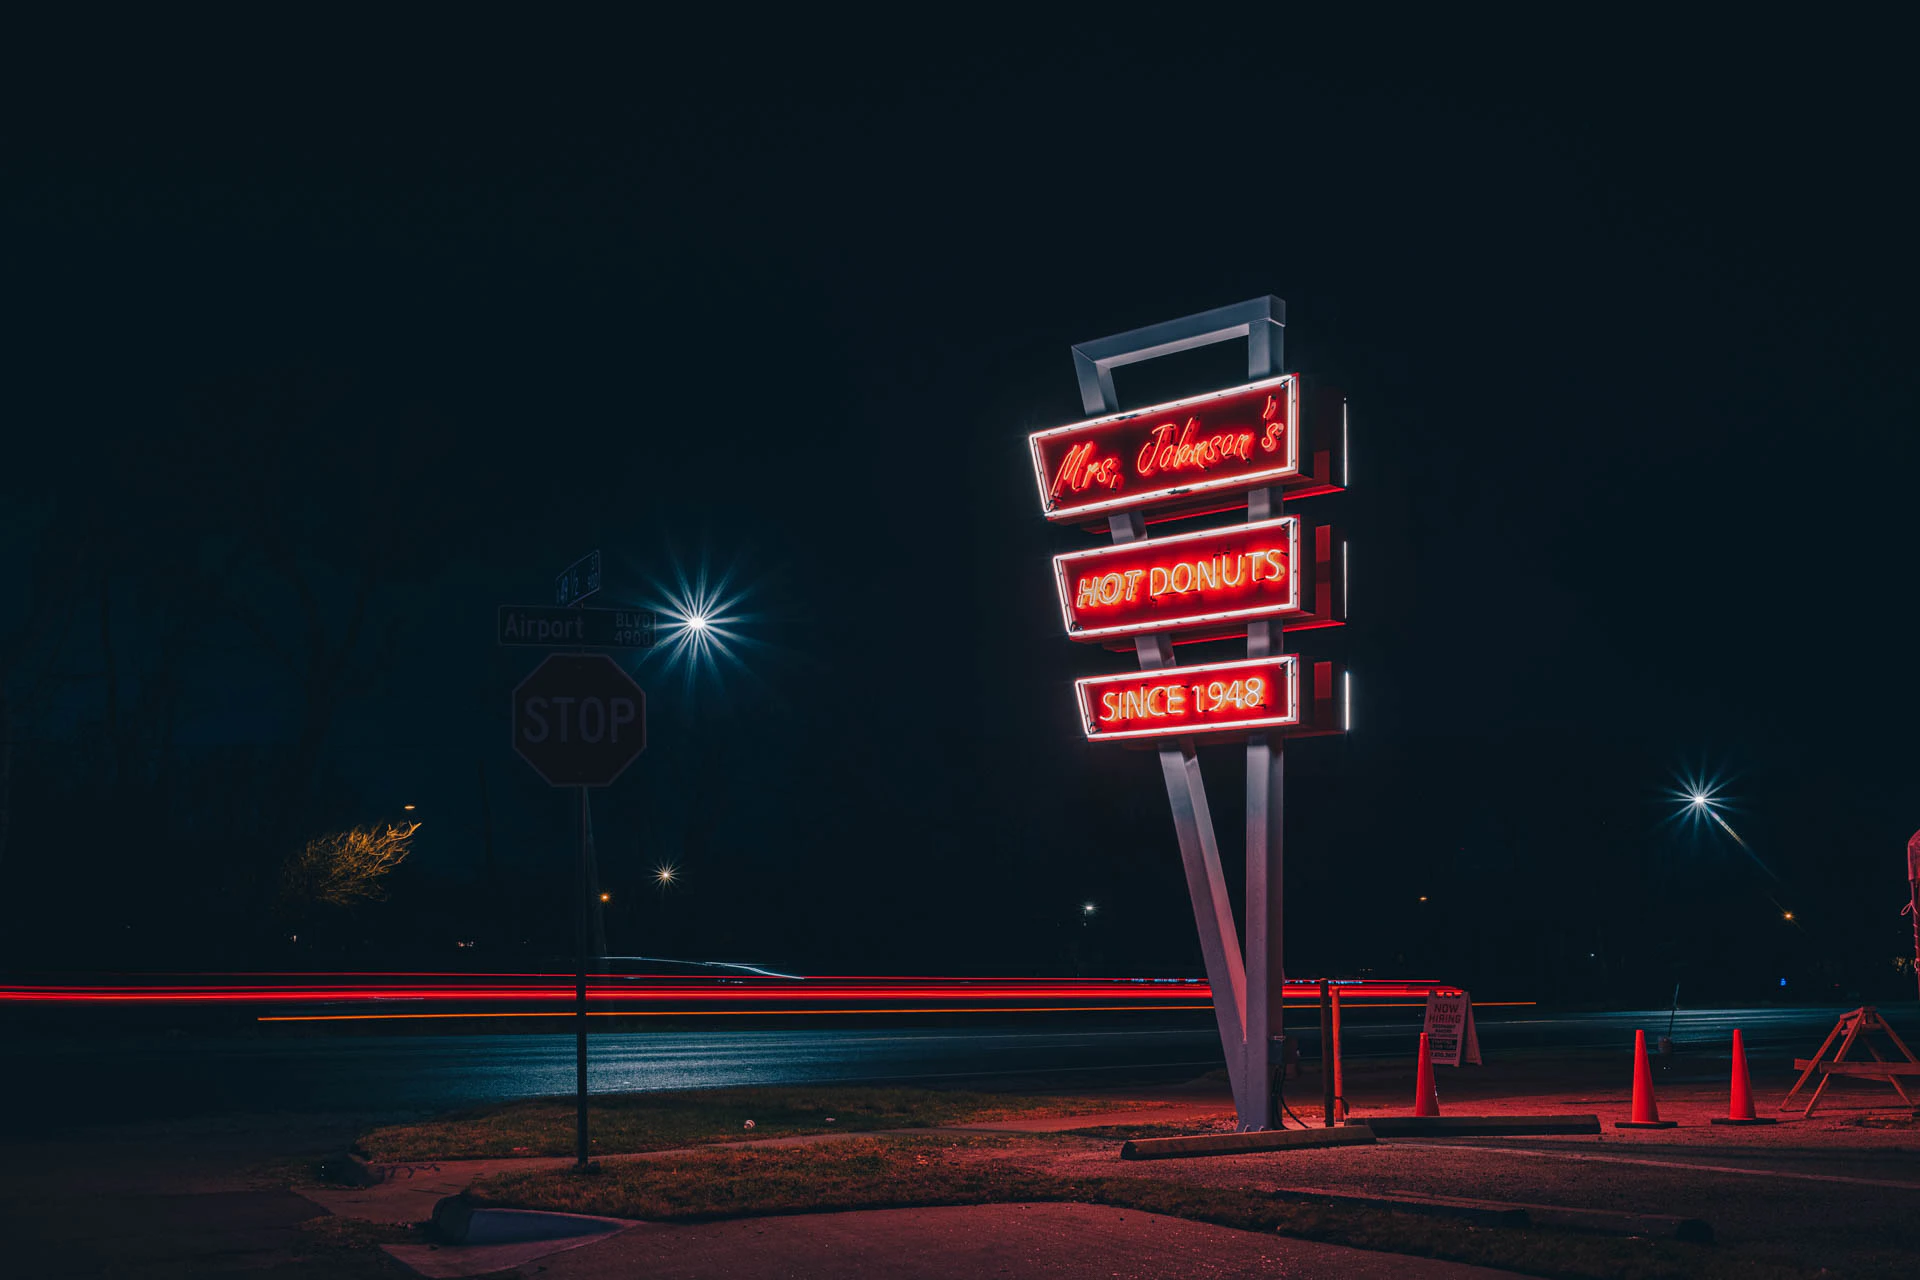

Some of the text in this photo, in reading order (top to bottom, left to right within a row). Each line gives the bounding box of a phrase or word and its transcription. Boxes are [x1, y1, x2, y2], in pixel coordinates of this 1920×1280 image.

[1077, 548, 1286, 609] HOT DONUTS
[504, 613, 585, 642] Airport
[615, 612, 650, 628] BLVD
[1099, 677, 1264, 722] SINCE 1948
[522, 695, 636, 744] STOP
[1429, 1014, 1462, 1024] HIRING
[1434, 1003, 1460, 1013] NOW
